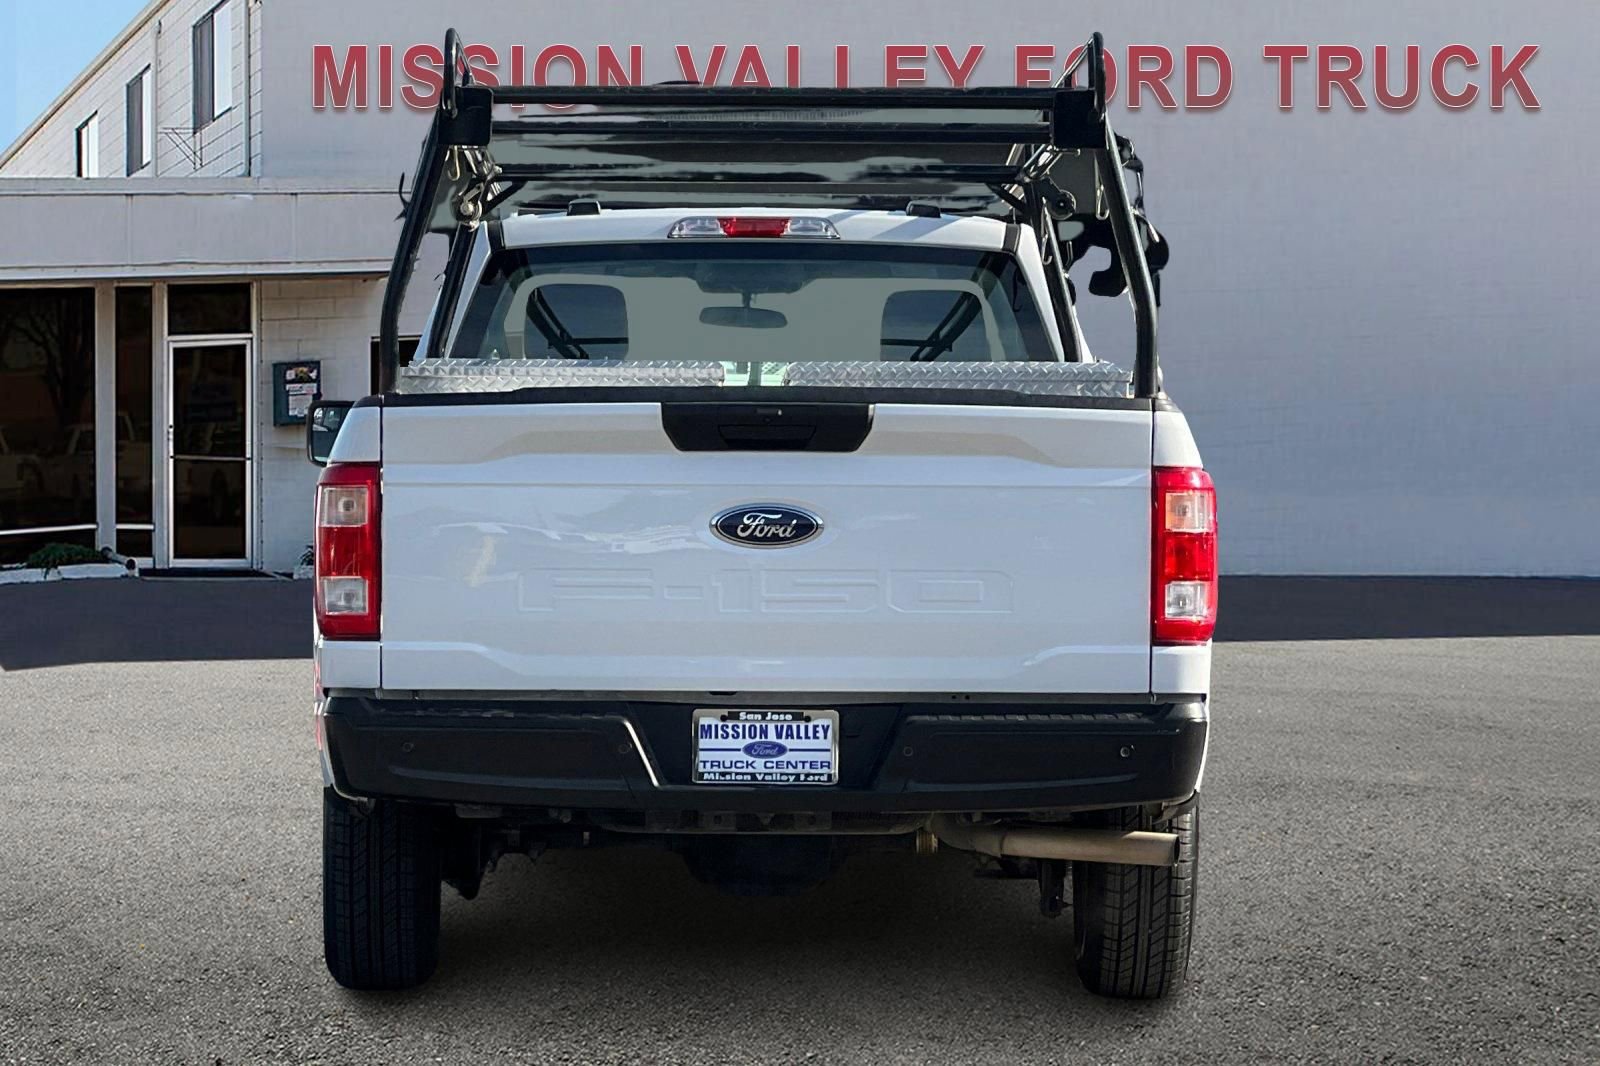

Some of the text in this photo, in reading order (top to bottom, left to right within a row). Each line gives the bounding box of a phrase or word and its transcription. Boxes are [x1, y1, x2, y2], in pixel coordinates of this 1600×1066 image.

[675, 44, 985, 88] VALLEY
[1015, 44, 1234, 108] FORD
[1264, 44, 1541, 108] TRUCK
[736, 511, 796, 538] Ford
[518, 567, 1014, 614] F-150
[739, 711, 793, 721] San Jose
[700, 724, 830, 740] MISSION VALLEY
[751, 743, 779, 756] Ford
[700, 760, 831, 770] TRUCK CENTER
[756, 772, 796, 782] Valley
